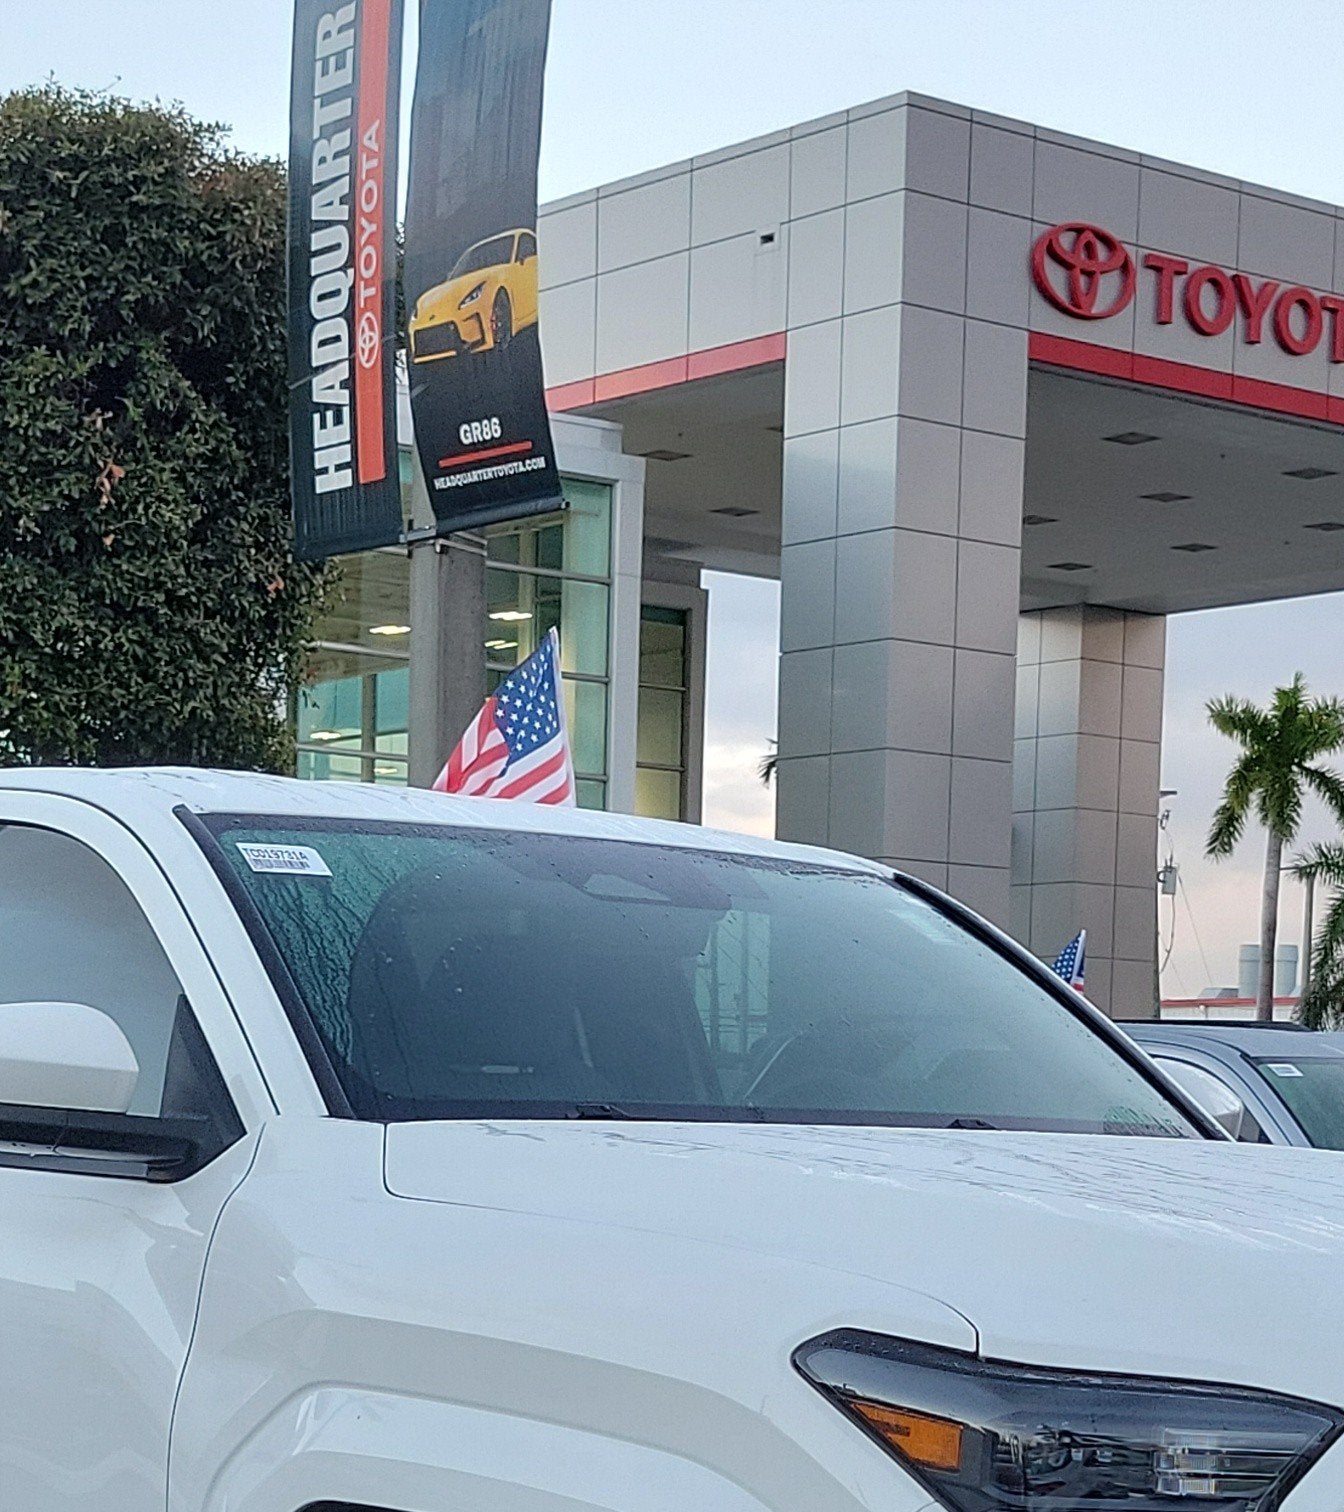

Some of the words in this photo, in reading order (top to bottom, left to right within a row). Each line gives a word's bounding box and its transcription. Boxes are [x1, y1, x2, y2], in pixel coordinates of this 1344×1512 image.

[309, 1, 356, 495] HEADQUARTER
[360, 118, 381, 308] TOYOTA
[434, 456, 546, 490] HEADQUARTERTOYOTA.COM
[459, 417, 502, 445] GR86
